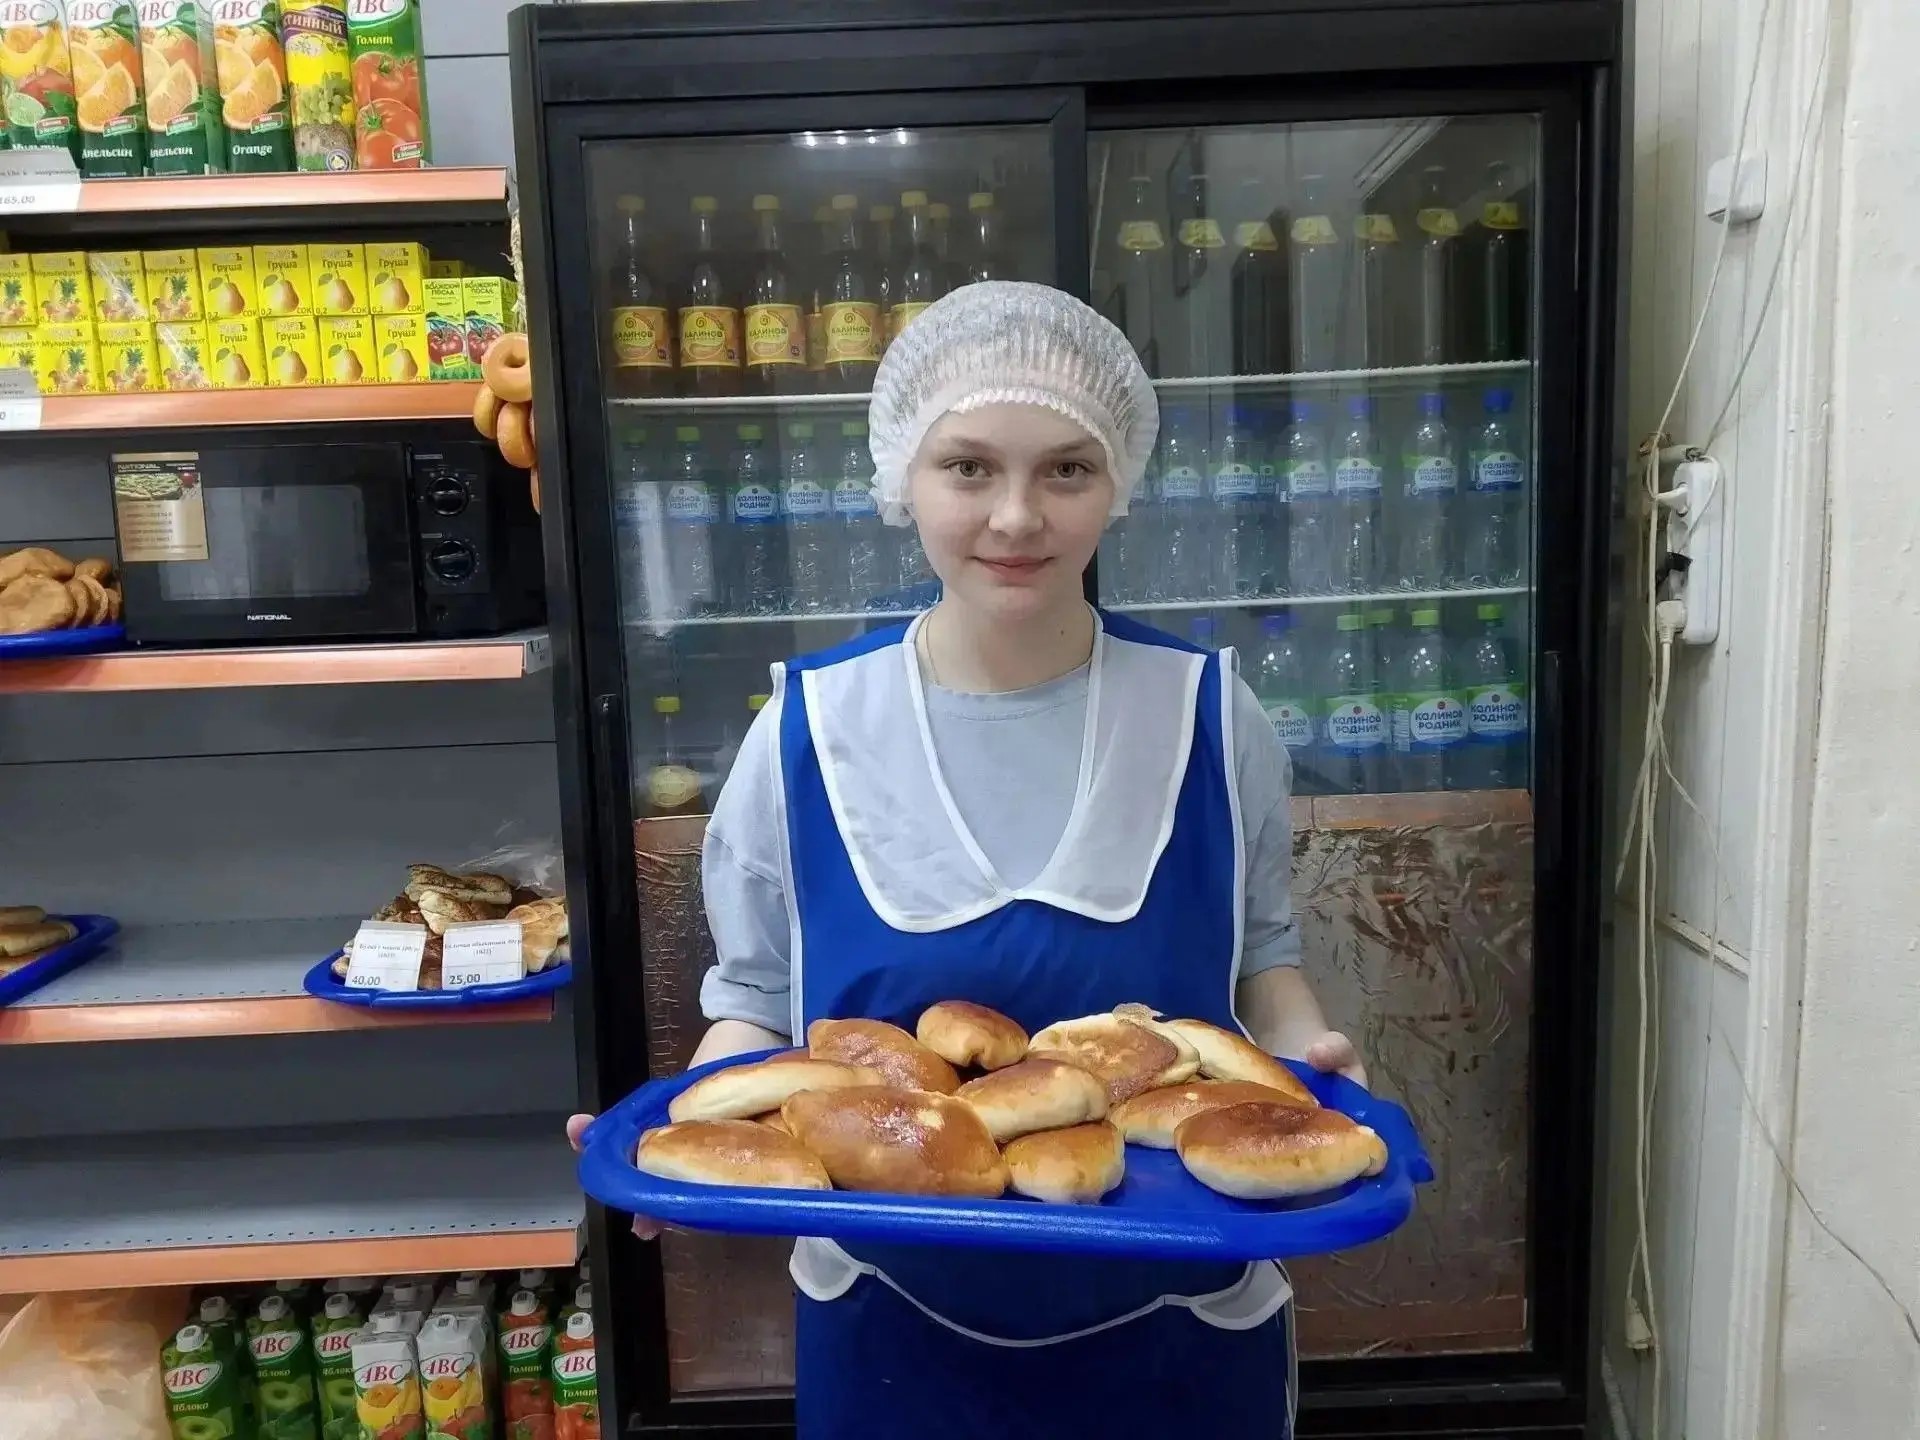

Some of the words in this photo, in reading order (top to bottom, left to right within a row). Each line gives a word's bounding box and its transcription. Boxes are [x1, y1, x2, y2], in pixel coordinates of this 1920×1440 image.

[232, 144, 273, 156] Orange
[212, 262, 242, 272] Груша
[268, 261, 298, 271] Груша
[322, 259, 352, 269] Груша
[379, 258, 409, 268] Груша
[220, 333, 248, 343] Груша
[276, 332, 306, 341] Груша
[332, 330, 362, 340] Груша
[388, 329, 416, 339] Груша
[1473, 712, 1519, 723] РОДНИК
[1335, 724, 1380, 735] РОДНИК
[1418, 720, 1461, 730] РОДНИК
[352, 975, 381, 986] 40,00
[449, 973, 481, 986] 25,00
